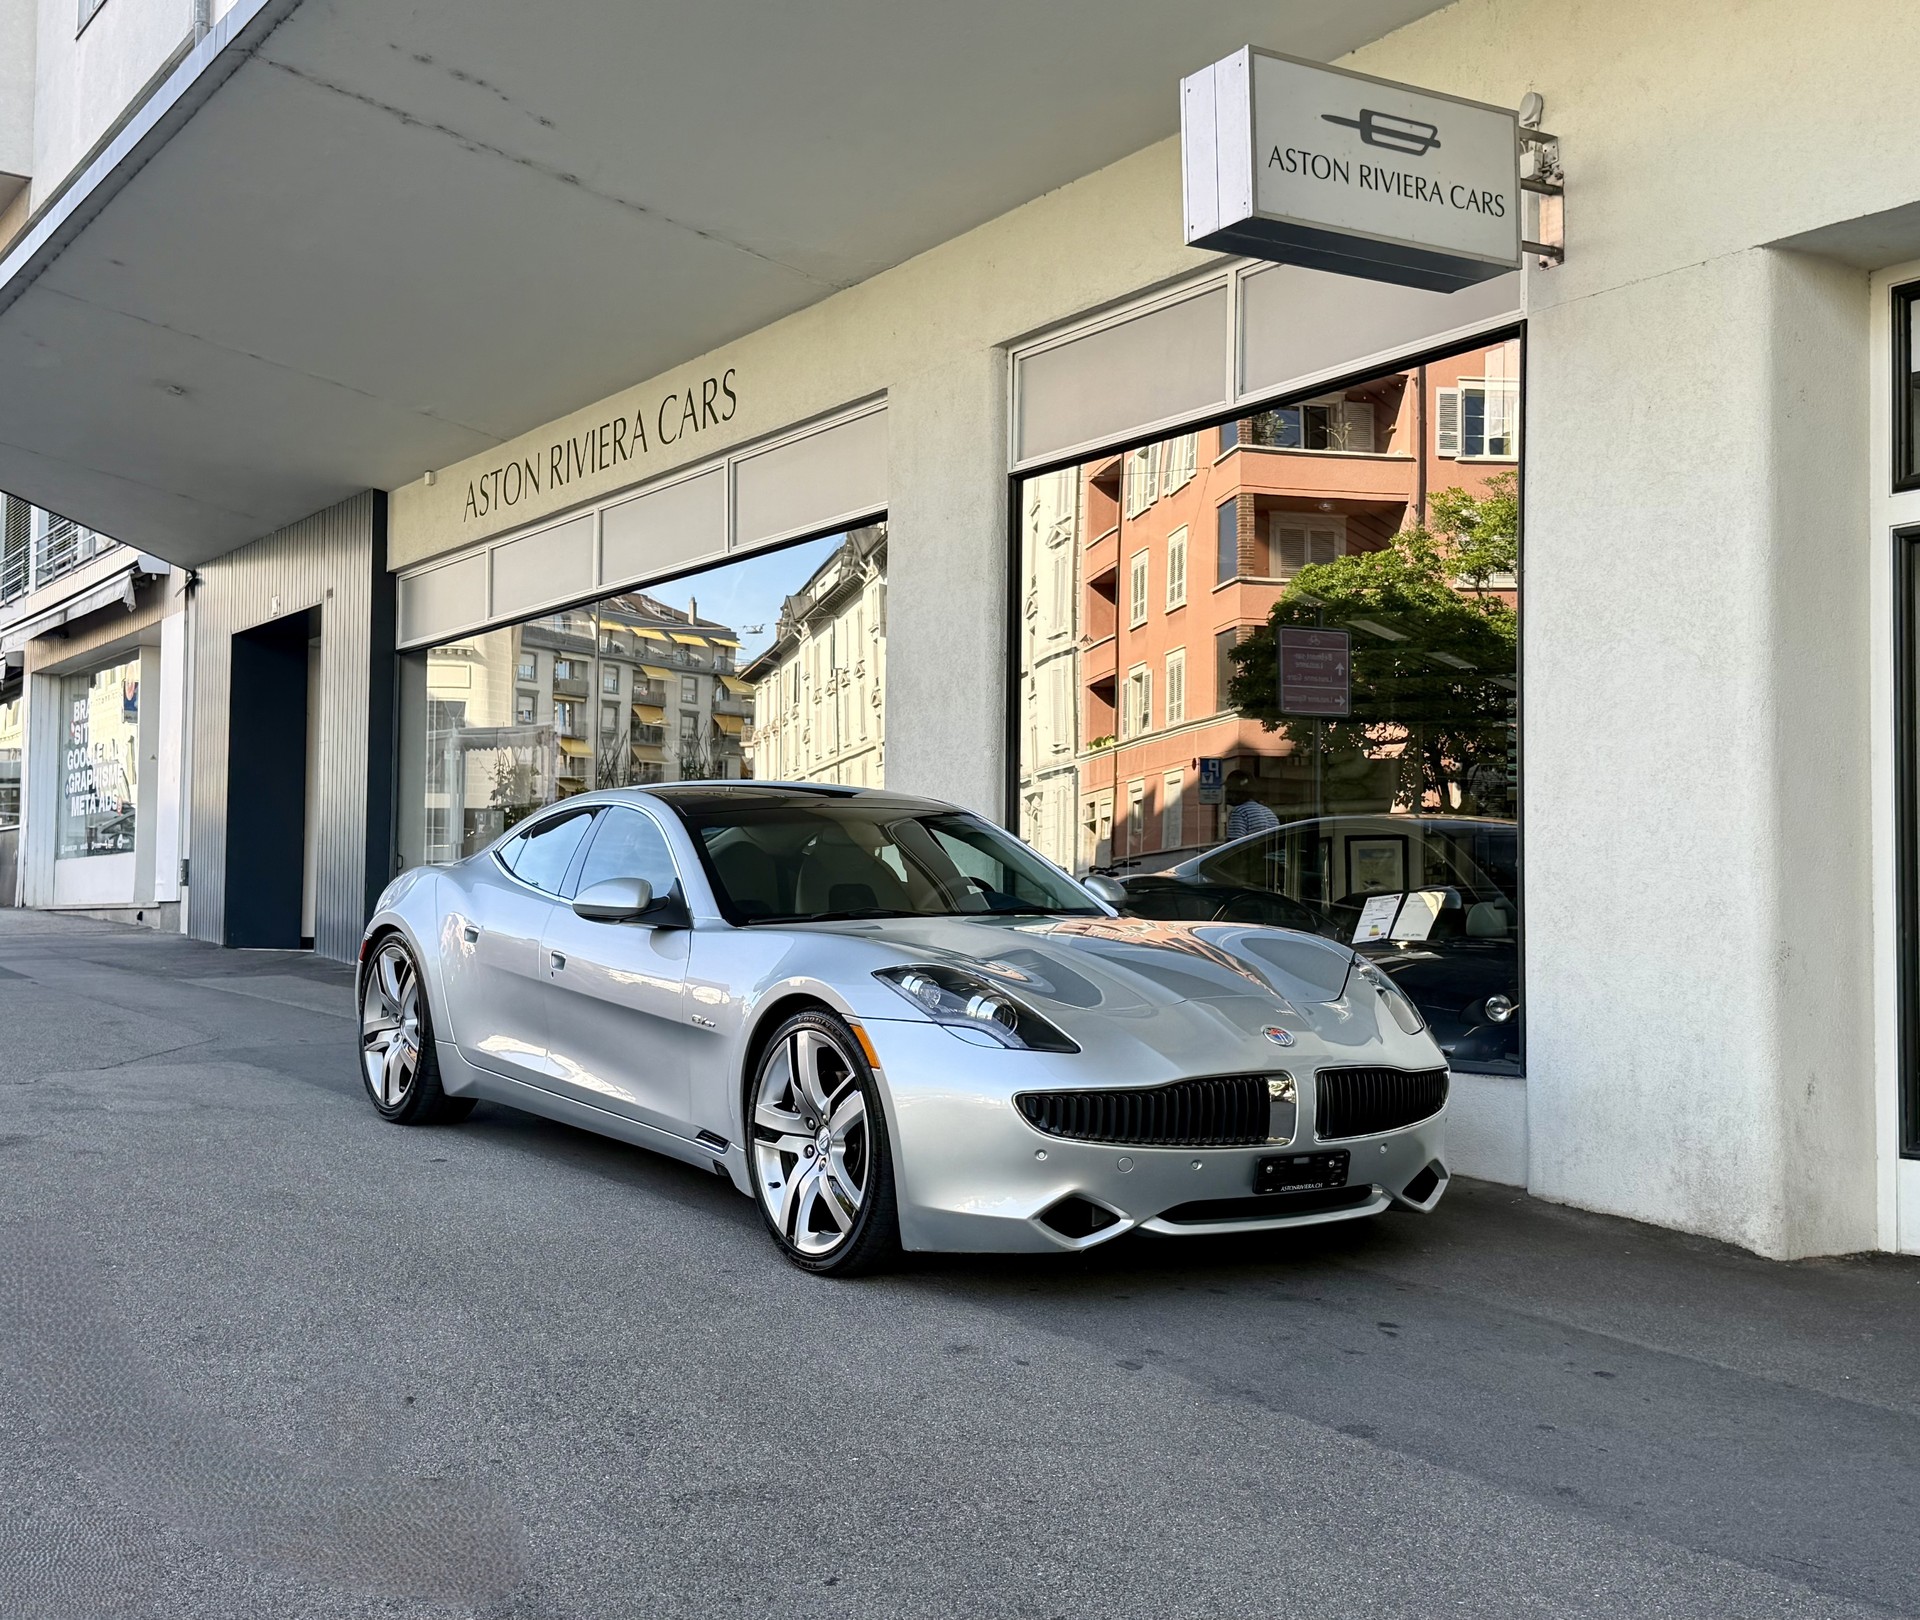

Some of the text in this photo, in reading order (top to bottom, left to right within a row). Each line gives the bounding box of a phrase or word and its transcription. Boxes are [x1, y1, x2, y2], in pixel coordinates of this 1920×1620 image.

[1268, 145, 1505, 218] ASTON RIVIERA CARS
[463, 368, 737, 522] ASTON RIVIERA CARS
[67, 742, 104, 771] GOOGLE
[68, 764, 124, 794] GRAPHISME
[71, 788, 118, 817] META ADS
